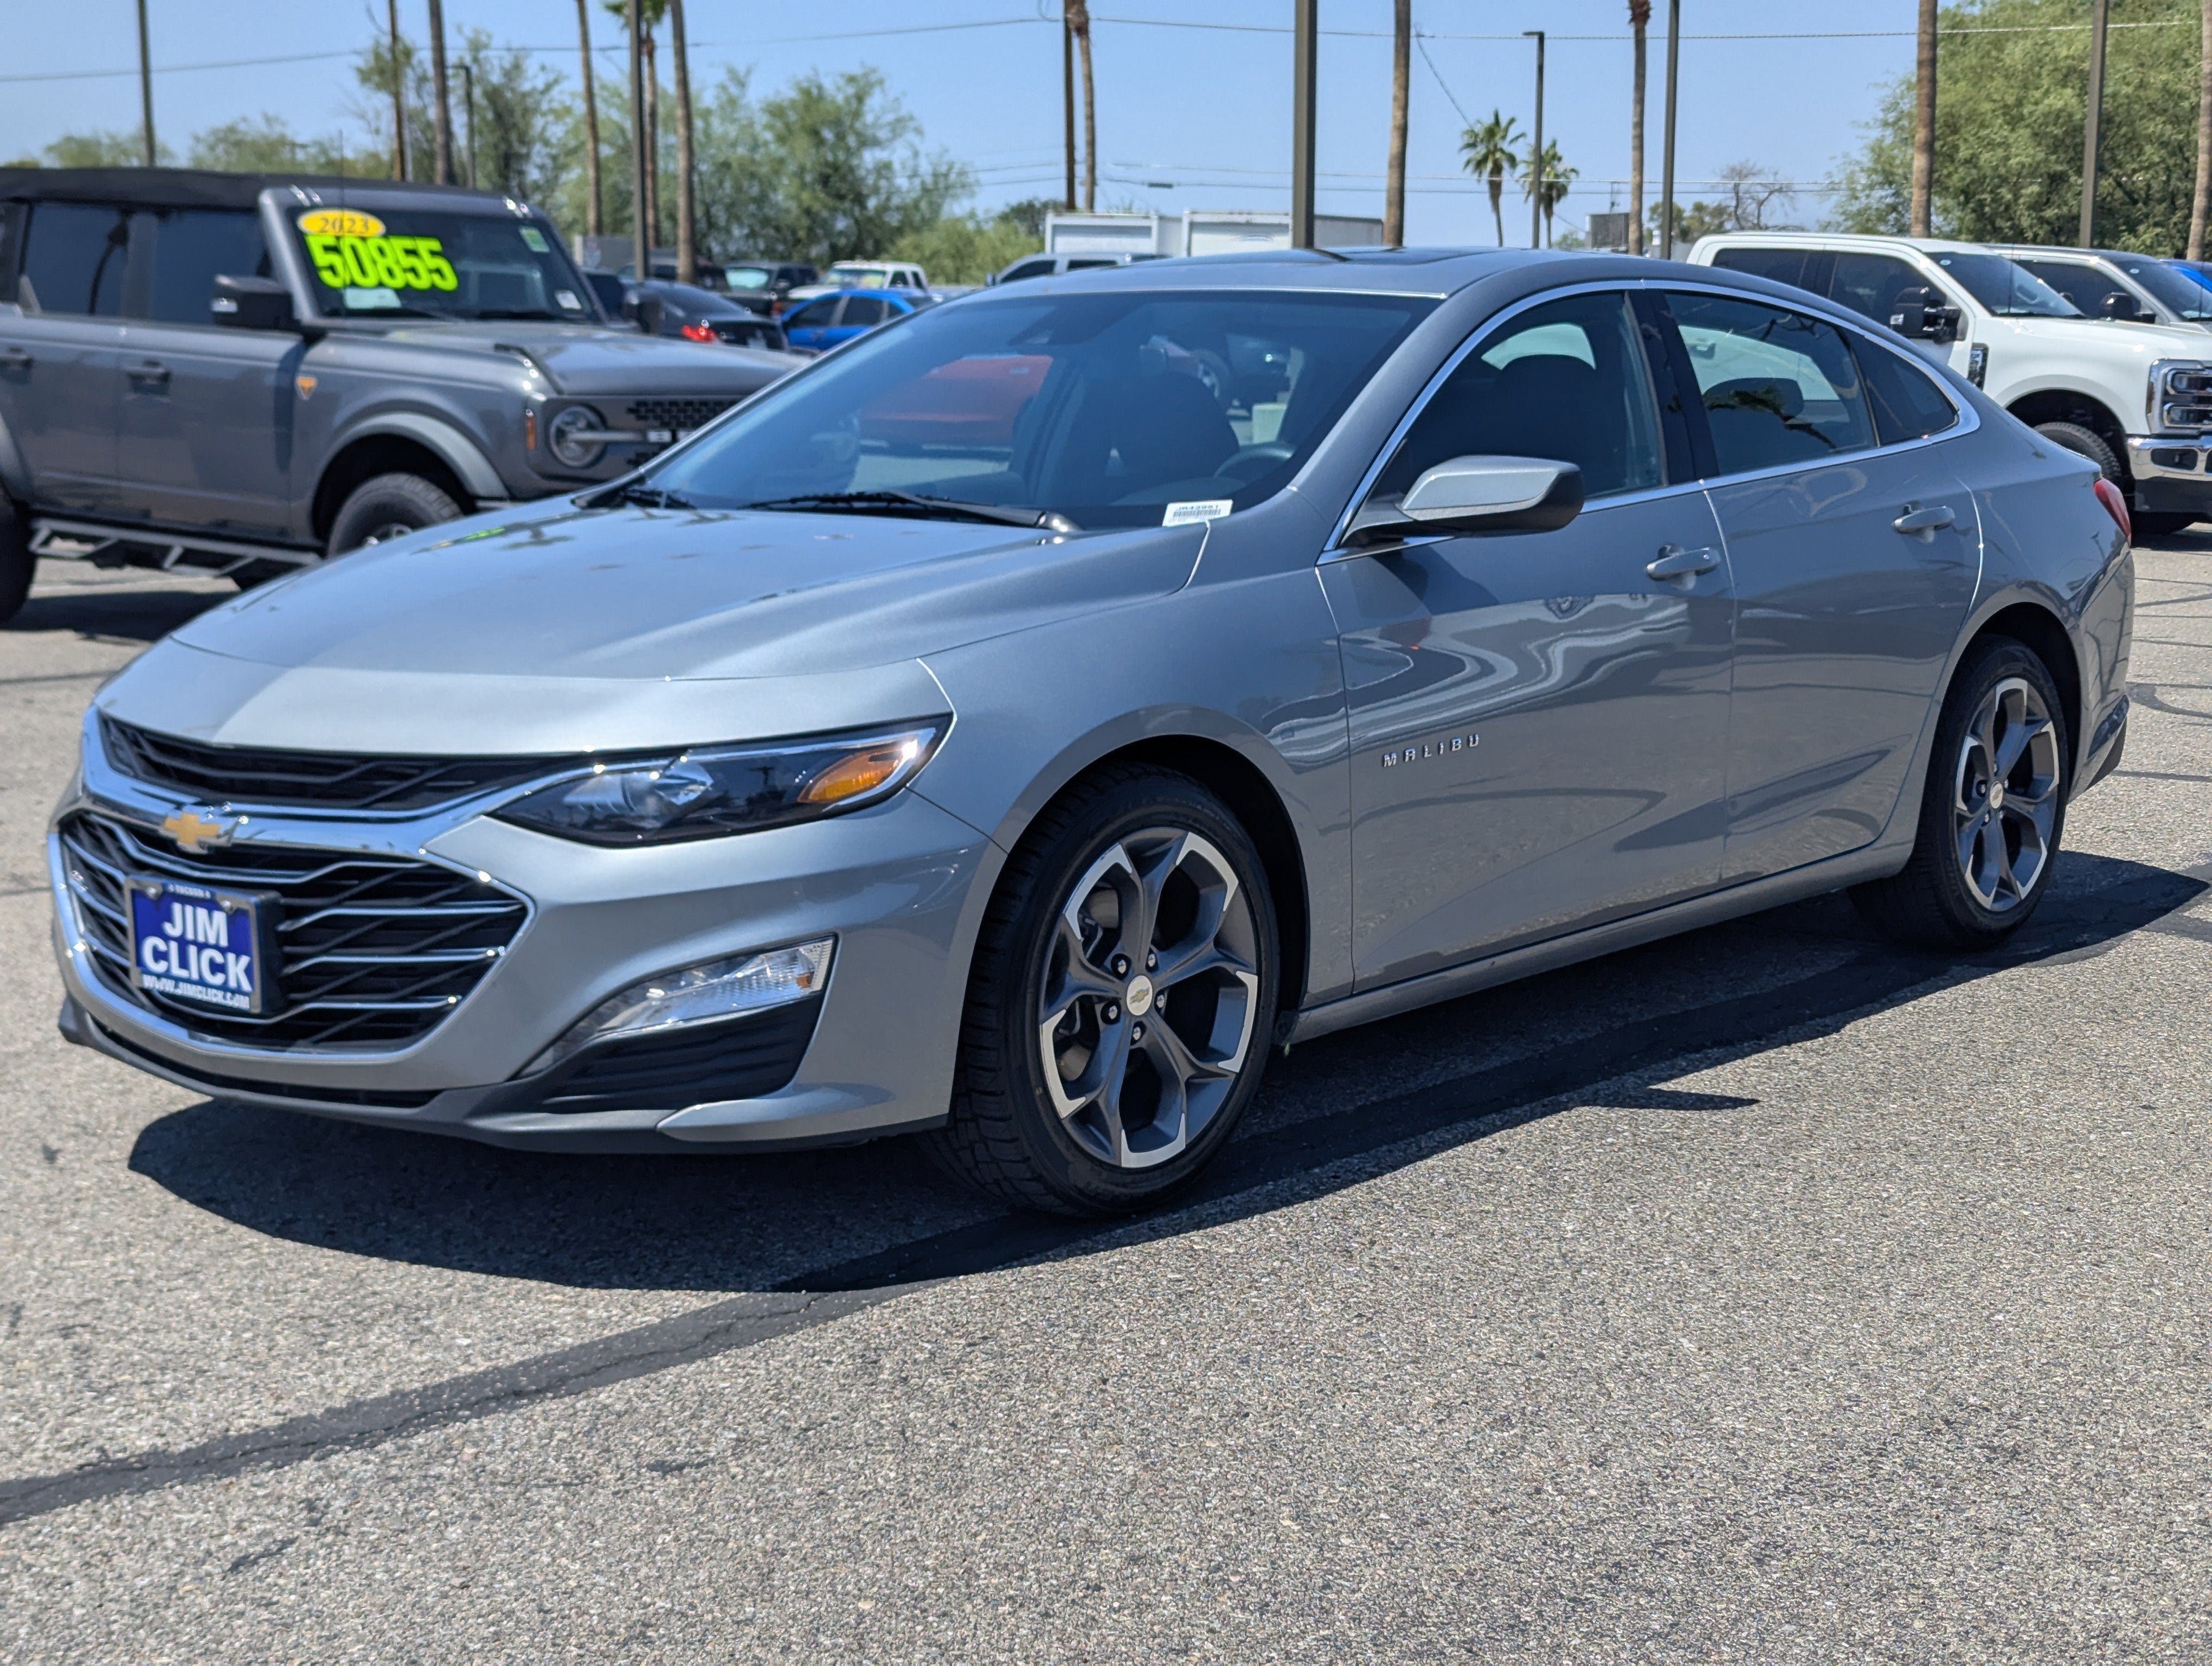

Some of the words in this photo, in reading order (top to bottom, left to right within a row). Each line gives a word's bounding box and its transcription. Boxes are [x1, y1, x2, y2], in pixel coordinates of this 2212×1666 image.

[319, 216, 370, 234] 2023
[305, 234, 458, 292] 50855
[1383, 733, 1480, 767] MALIBU
[162, 901, 228, 948] JIM
[141, 935, 253, 993] CLICK
